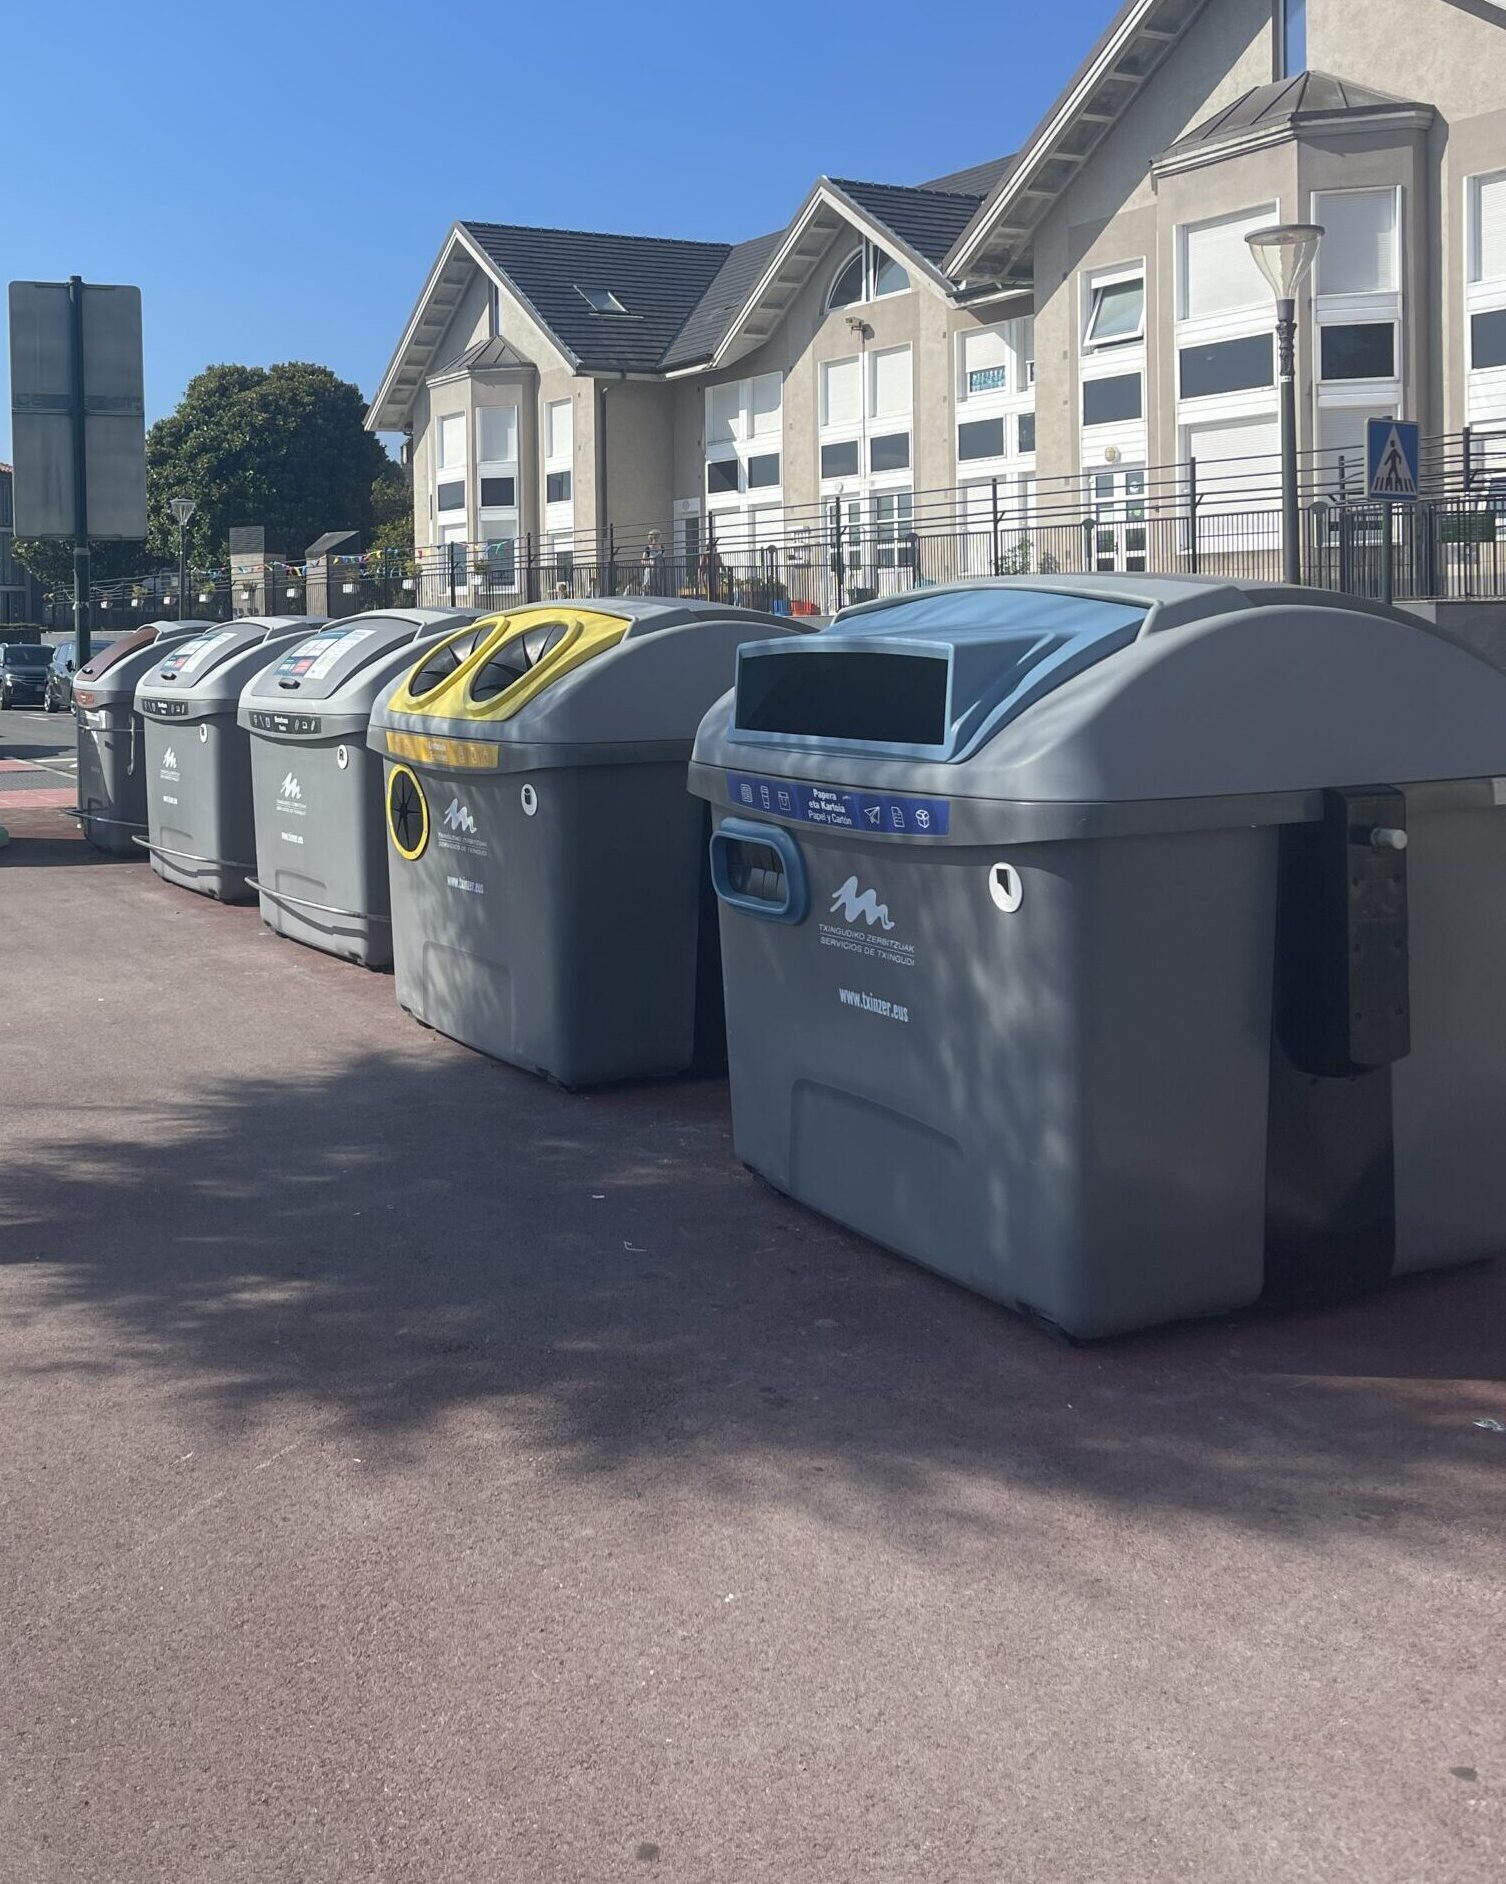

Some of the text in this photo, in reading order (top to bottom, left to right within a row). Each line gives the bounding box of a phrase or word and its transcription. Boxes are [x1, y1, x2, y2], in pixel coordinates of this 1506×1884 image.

[813, 788, 837, 801] Papera
[808, 809, 826, 822] Papel
[826, 814, 831, 823] y
[809, 800, 846, 813] eta Kartoia
[819, 923, 915, 953] TXINGUDIKO ZERBITZUAK
[820, 936, 915, 966] SERVICIOS DE TXINGUDI
[839, 987, 909, 1023] www.txinzer.eus
